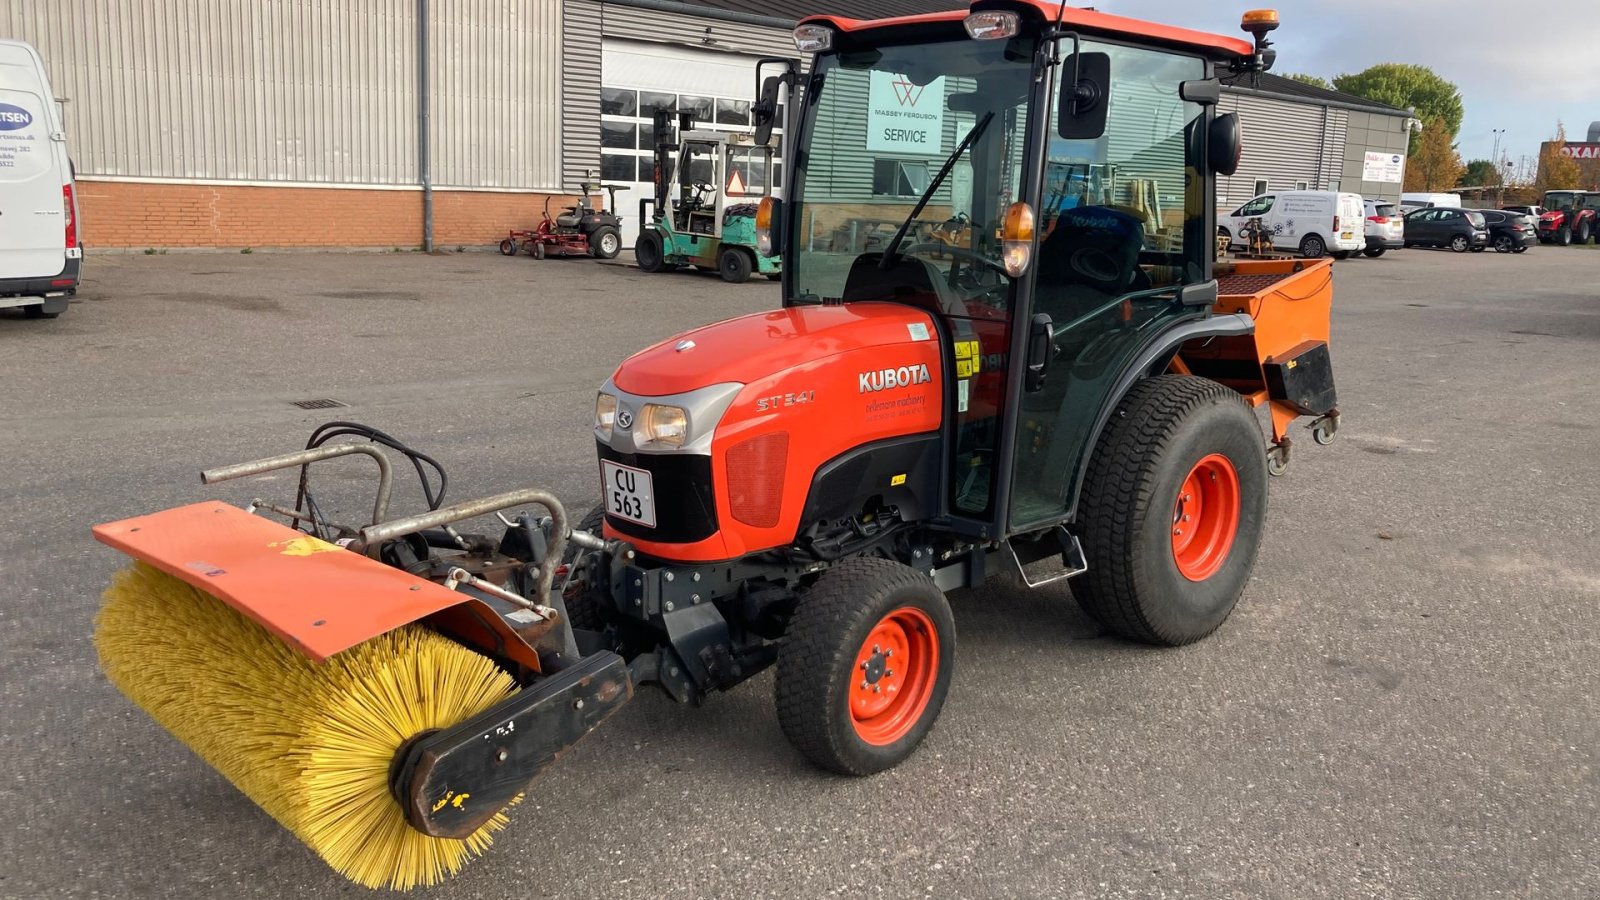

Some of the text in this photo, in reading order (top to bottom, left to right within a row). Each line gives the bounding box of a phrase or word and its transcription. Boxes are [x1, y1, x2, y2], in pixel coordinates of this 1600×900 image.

[874, 109, 937, 120] MASSEY FERGUSON
[884, 128, 927, 143] SERVICE
[858, 362, 932, 394] KUBOTA
[896, 393, 926, 407] machinery
[615, 469, 635, 493] CU
[614, 491, 642, 518] 563
